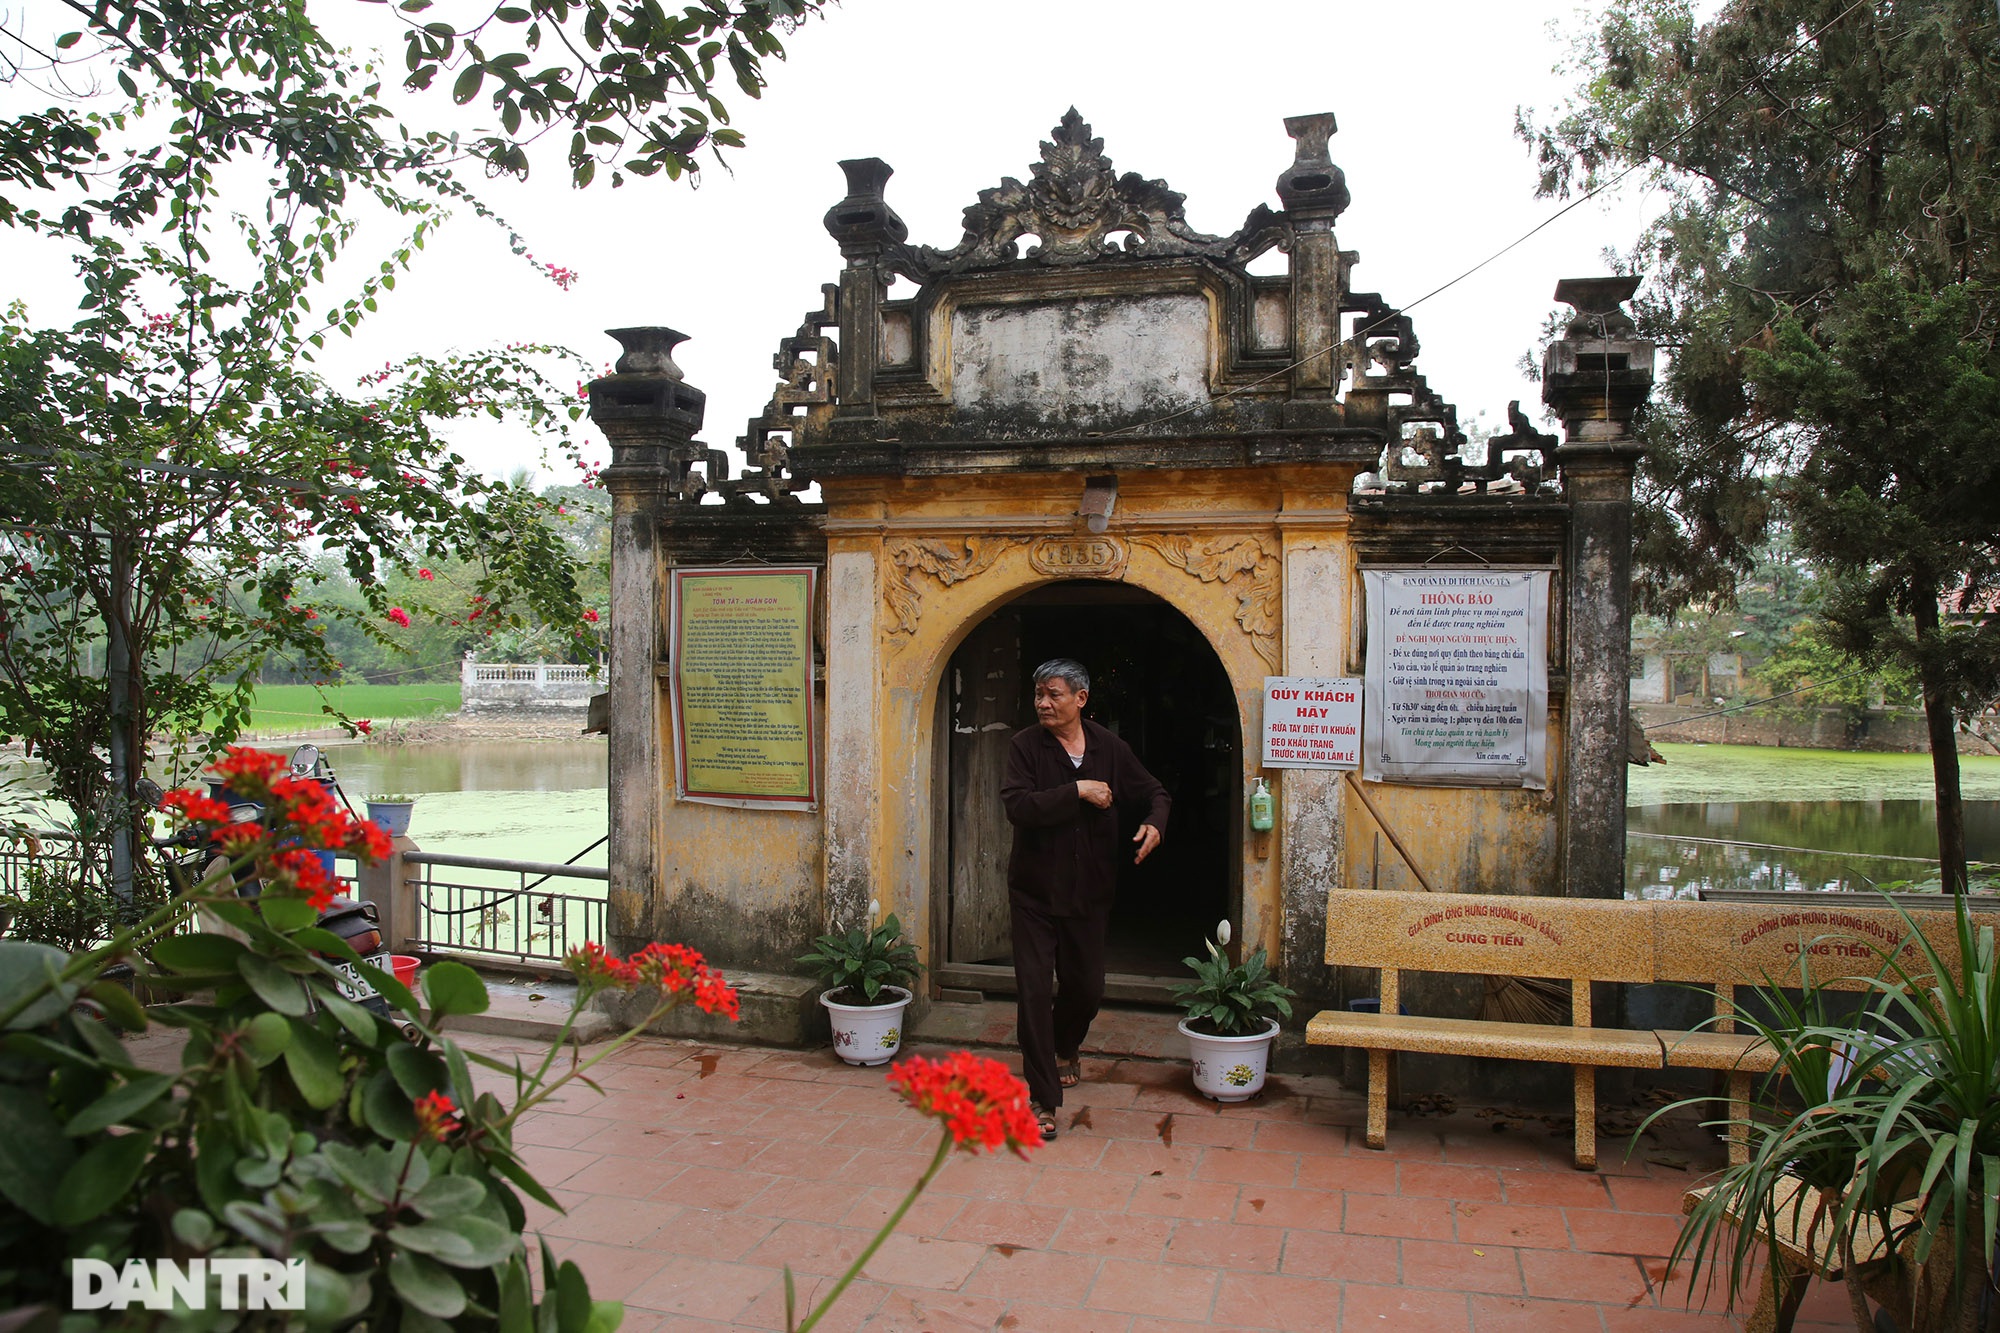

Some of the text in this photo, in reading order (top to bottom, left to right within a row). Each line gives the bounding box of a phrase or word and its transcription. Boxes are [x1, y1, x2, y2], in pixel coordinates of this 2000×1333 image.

[1420, 591, 1493, 604] THÔNG BÁO
[1452, 608, 1471, 617] phục
[1484, 609, 1499, 618] mọi
[1501, 608, 1523, 617] người
[1408, 617, 1505, 629] đến lễ được trang nghiêm
[1271, 687, 1355, 702] QÚY KHÁCH
[1297, 705, 1328, 718] HÃY
[1272, 721, 1287, 732] RỬA
[1289, 724, 1301, 732] TAY
[1303, 723, 1319, 735] DIỆT
[1321, 725, 1328, 734] VI
[1271, 738, 1286, 747] ĐEO
[1310, 740, 1334, 749] TRANG
[1271, 748, 1295, 759] TRƯỚC
[1297, 751, 1309, 759] KHI
[1311, 749, 1325, 760] VÀO
[1328, 750, 1343, 761] LÀM
[1408, 922, 1423, 937] GIA
[1423, 911, 1444, 928] ĐÌNH
[1445, 906, 1463, 920] ÔNG
[1741, 929, 1757, 945] GIA
[1758, 917, 1779, 934] ĐÌNH
[1781, 912, 1800, 927] ÔNG
[1446, 932, 1524, 946] CUNG TIẾN
